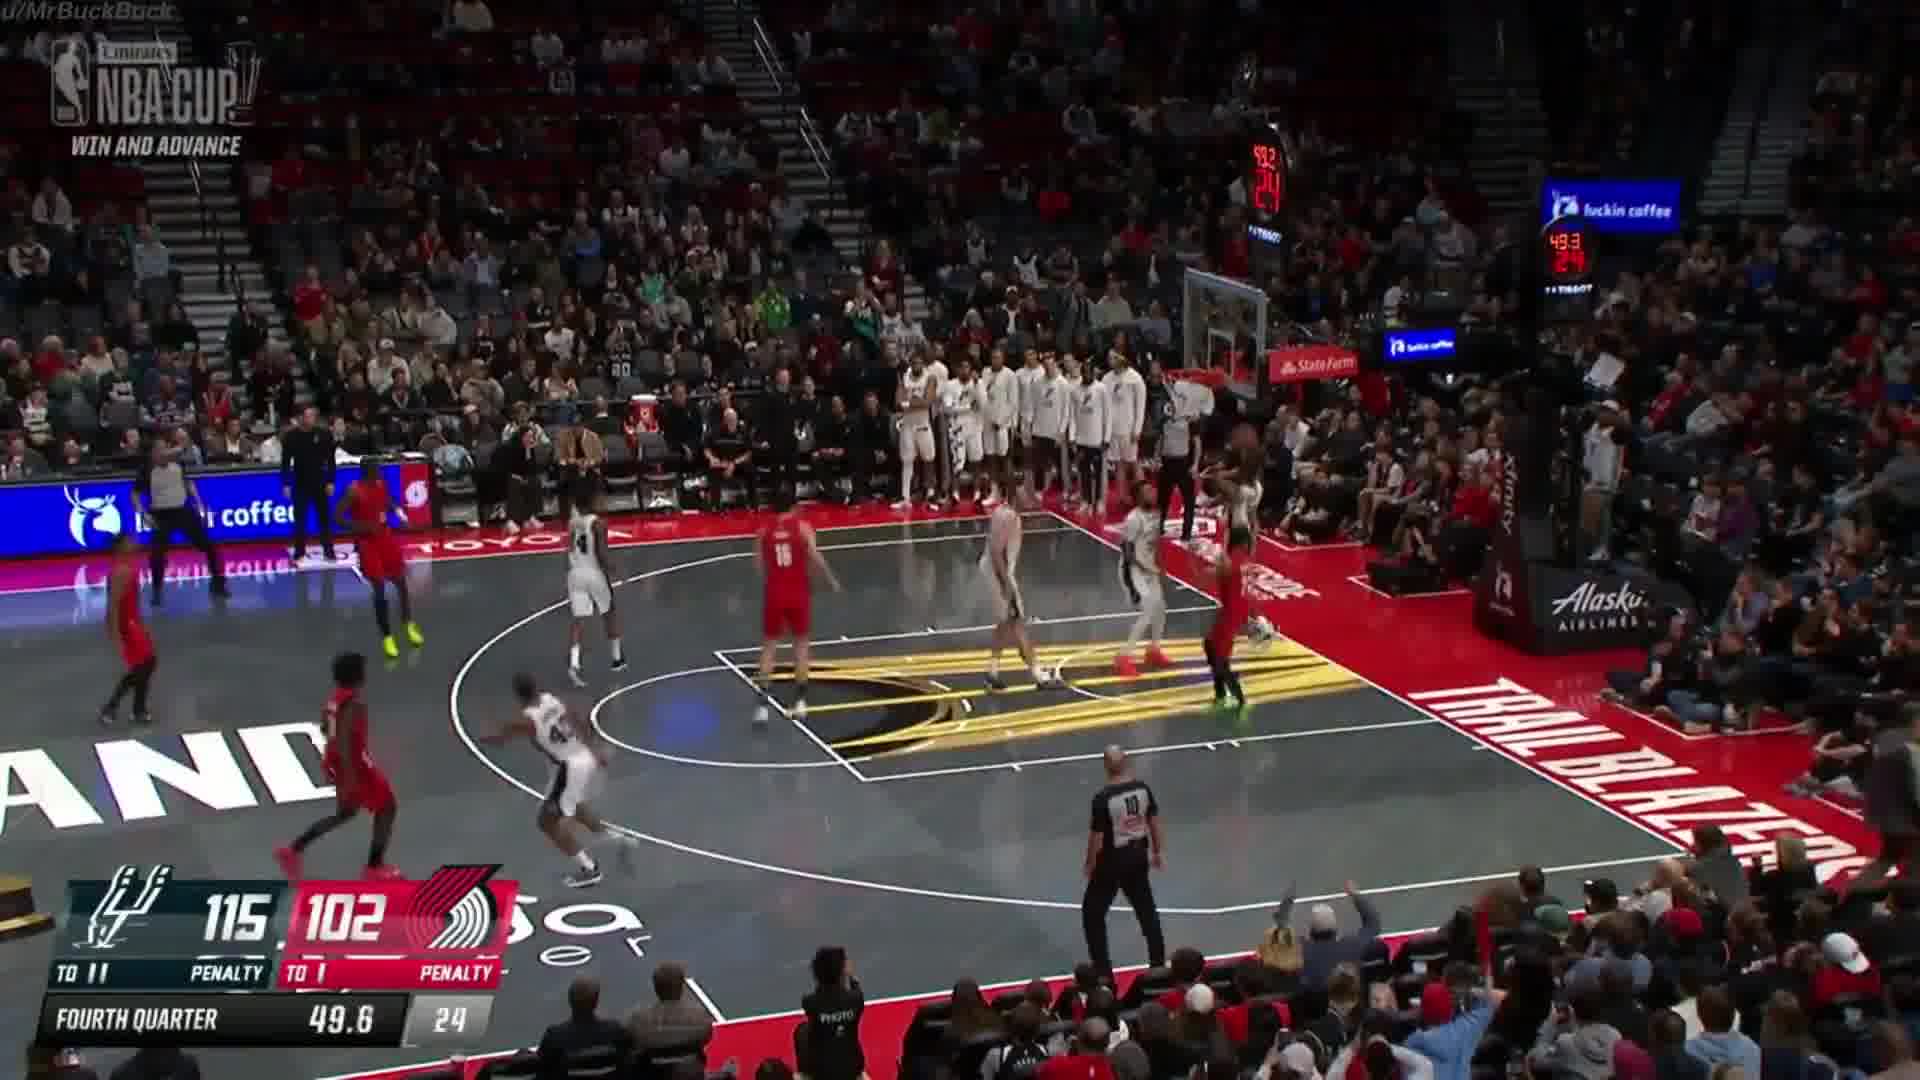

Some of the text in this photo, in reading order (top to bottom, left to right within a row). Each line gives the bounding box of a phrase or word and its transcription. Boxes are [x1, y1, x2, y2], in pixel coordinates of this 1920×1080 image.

[1584, 203, 1672, 219] luckin coffee
[1407, 676, 1625, 757] TRAIL
